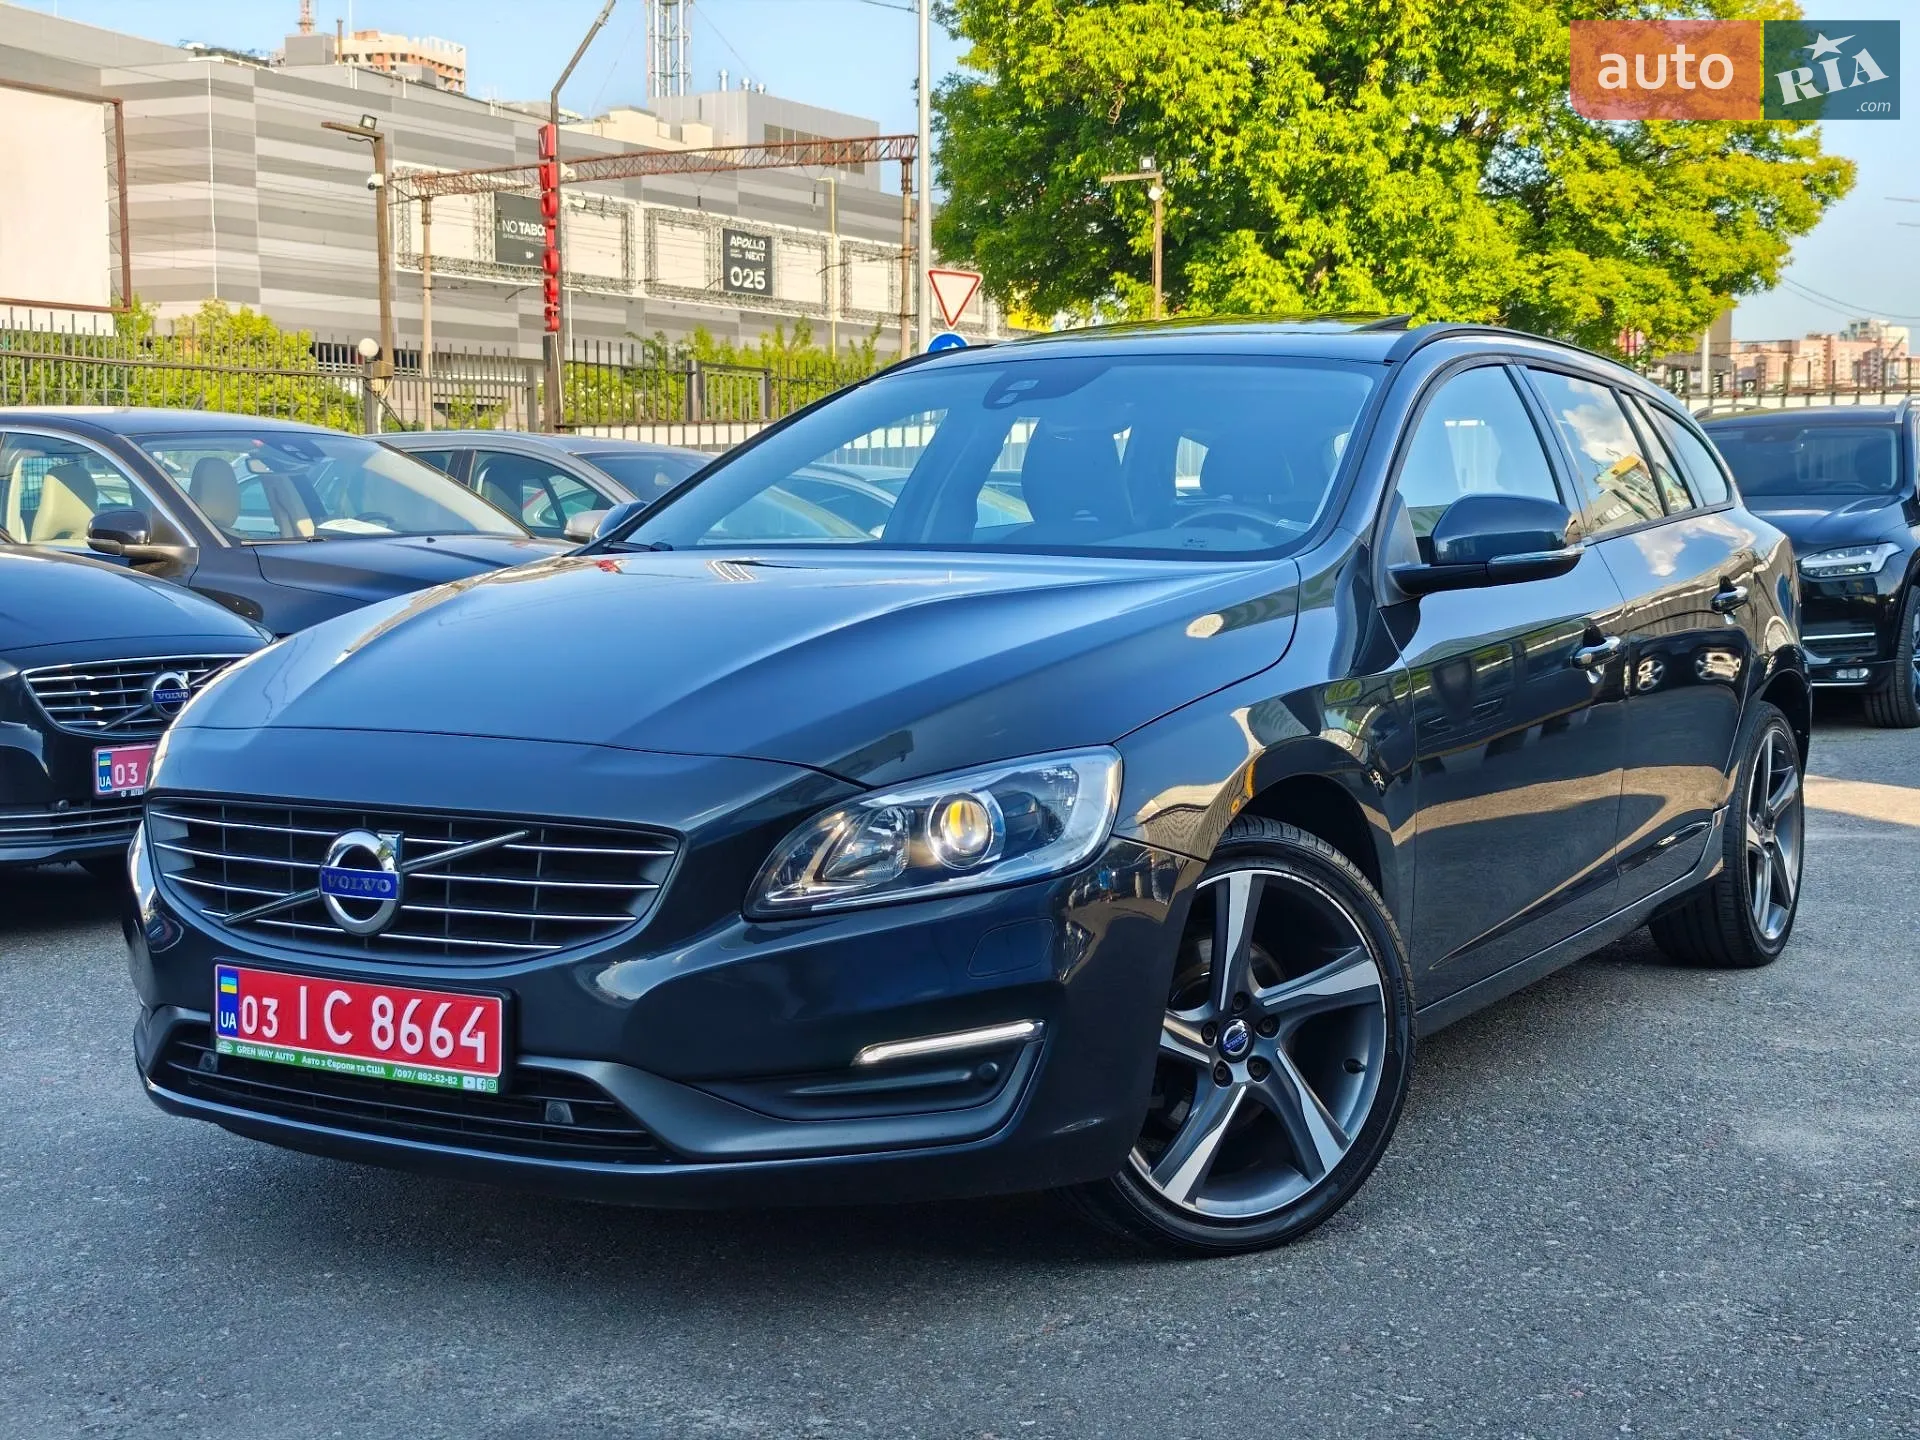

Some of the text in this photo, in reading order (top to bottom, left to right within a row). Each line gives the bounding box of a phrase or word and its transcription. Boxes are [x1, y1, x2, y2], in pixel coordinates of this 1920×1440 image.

[502, 219, 518, 233] NO
[730, 235, 766, 250] APOLLO
[745, 251, 766, 262] NEXT
[730, 266, 766, 290] 025
[156, 690, 189, 701] VOLVO
[99, 775, 112, 787] UA
[114, 762, 139, 785] 03
[326, 874, 392, 893] VOLVO
[220, 1011, 237, 1030] UA
[241, 995, 279, 1039] 03
[371, 995, 487, 1064] 8664
[236, 1045, 295, 1062] GREN WAY AUTO
[301, 1056, 320, 1066] Авто
[327, 1059, 355, 1071] Європи
[356, 1064, 365, 1073] та
[366, 1065, 385, 1075] США
